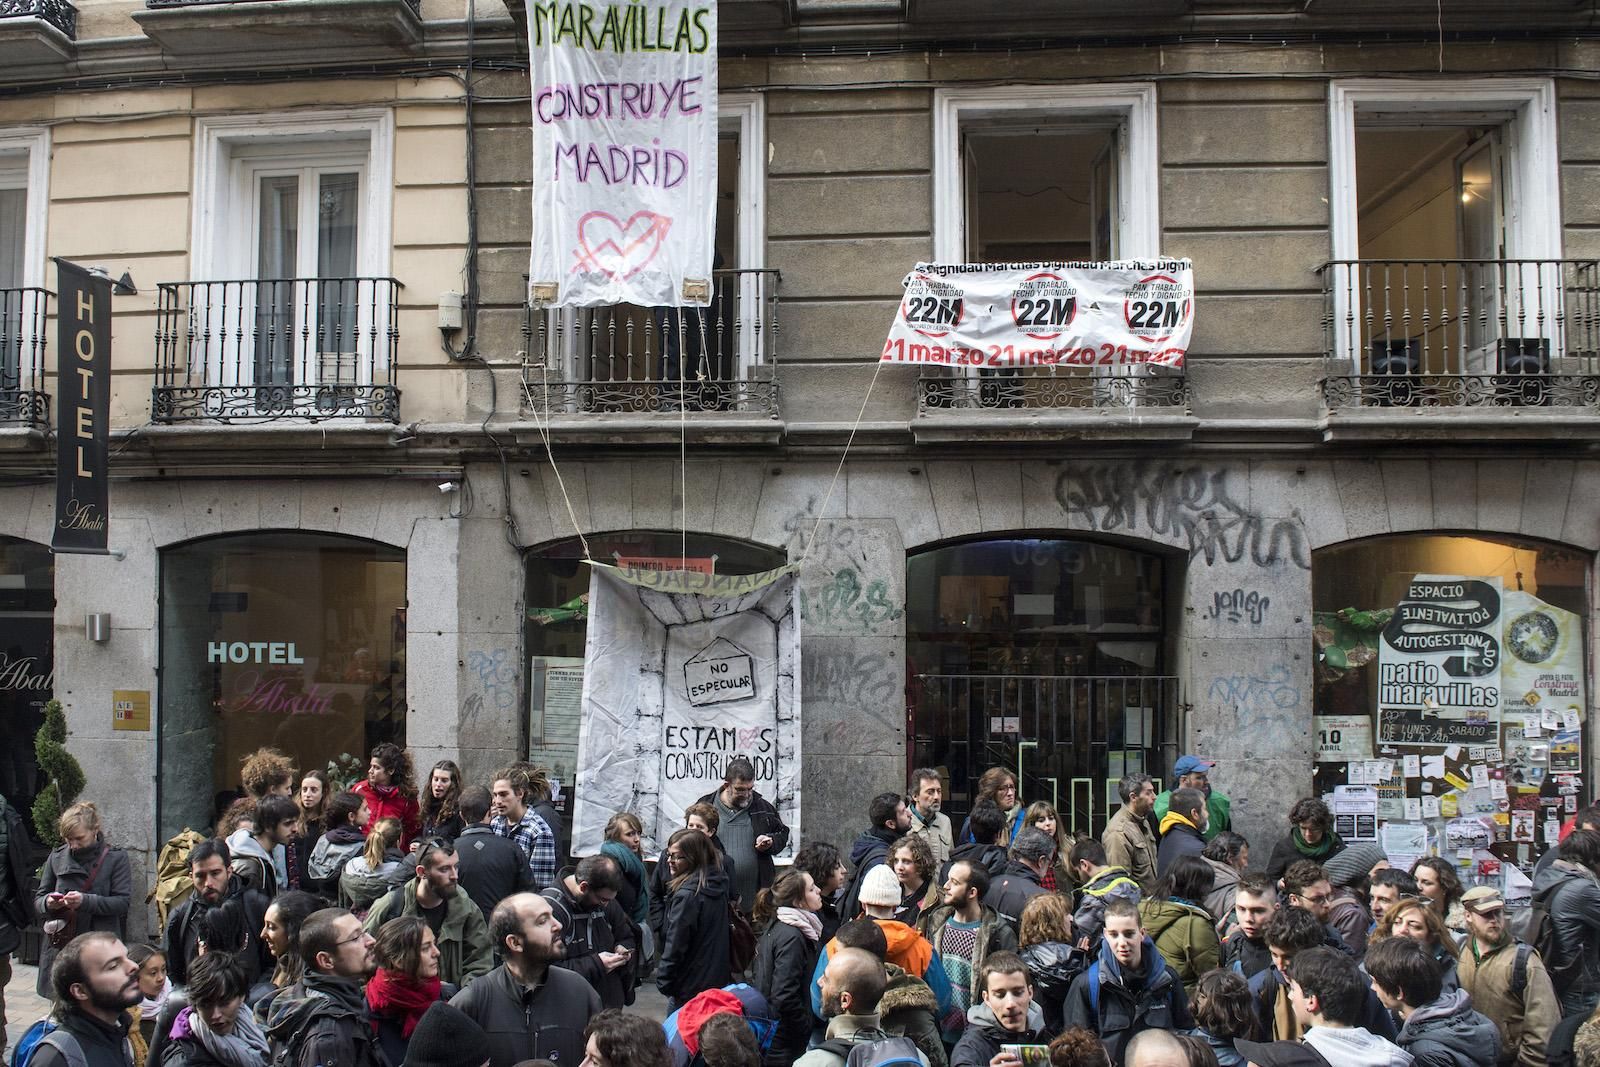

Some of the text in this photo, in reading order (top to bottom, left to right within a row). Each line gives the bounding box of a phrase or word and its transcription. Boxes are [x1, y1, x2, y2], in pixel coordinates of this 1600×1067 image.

[535, 0, 710, 53] MARAVILLAS
[536, 77, 703, 124] CONSTRUYE
[1043, 288, 1077, 296] DIGNIDAD
[1125, 291, 1149, 299] TECHO
[1151, 291, 1155, 299] Y
[905, 296, 963, 326] 22M
[1016, 297, 1076, 327] 22M
[1129, 299, 1187, 329] 22M
[908, 343, 985, 366] marzo
[987, 344, 1014, 366] 21
[1019, 346, 1096, 365] marzo
[1098, 343, 1128, 365] 21
[74, 289, 95, 478] HOTEL
[1409, 585, 1464, 598] ESPACIO
[712, 602, 728, 613] 21
[1402, 607, 1491, 625] POLIVALENTE
[207, 641, 305, 664] HOTEL
[1393, 633, 1496, 668] AUTOGESTIONADO
[0, 652, 53, 690] Abal
[710, 663, 729, 674] NO
[1381, 660, 1439, 685] patio
[691, 675, 751, 697] ESPECULAR
[1381, 682, 1499, 708] maravillas
[1318, 730, 1341, 745] 10
[1383, 724, 1395, 734] DE
[1401, 724, 1432, 735] LUNES
[1448, 725, 1486, 736] SABADO
[1383, 733, 1394, 741] DE
[1402, 733, 1413, 742] 19
[665, 751, 774, 781] CONSTRUNDO
